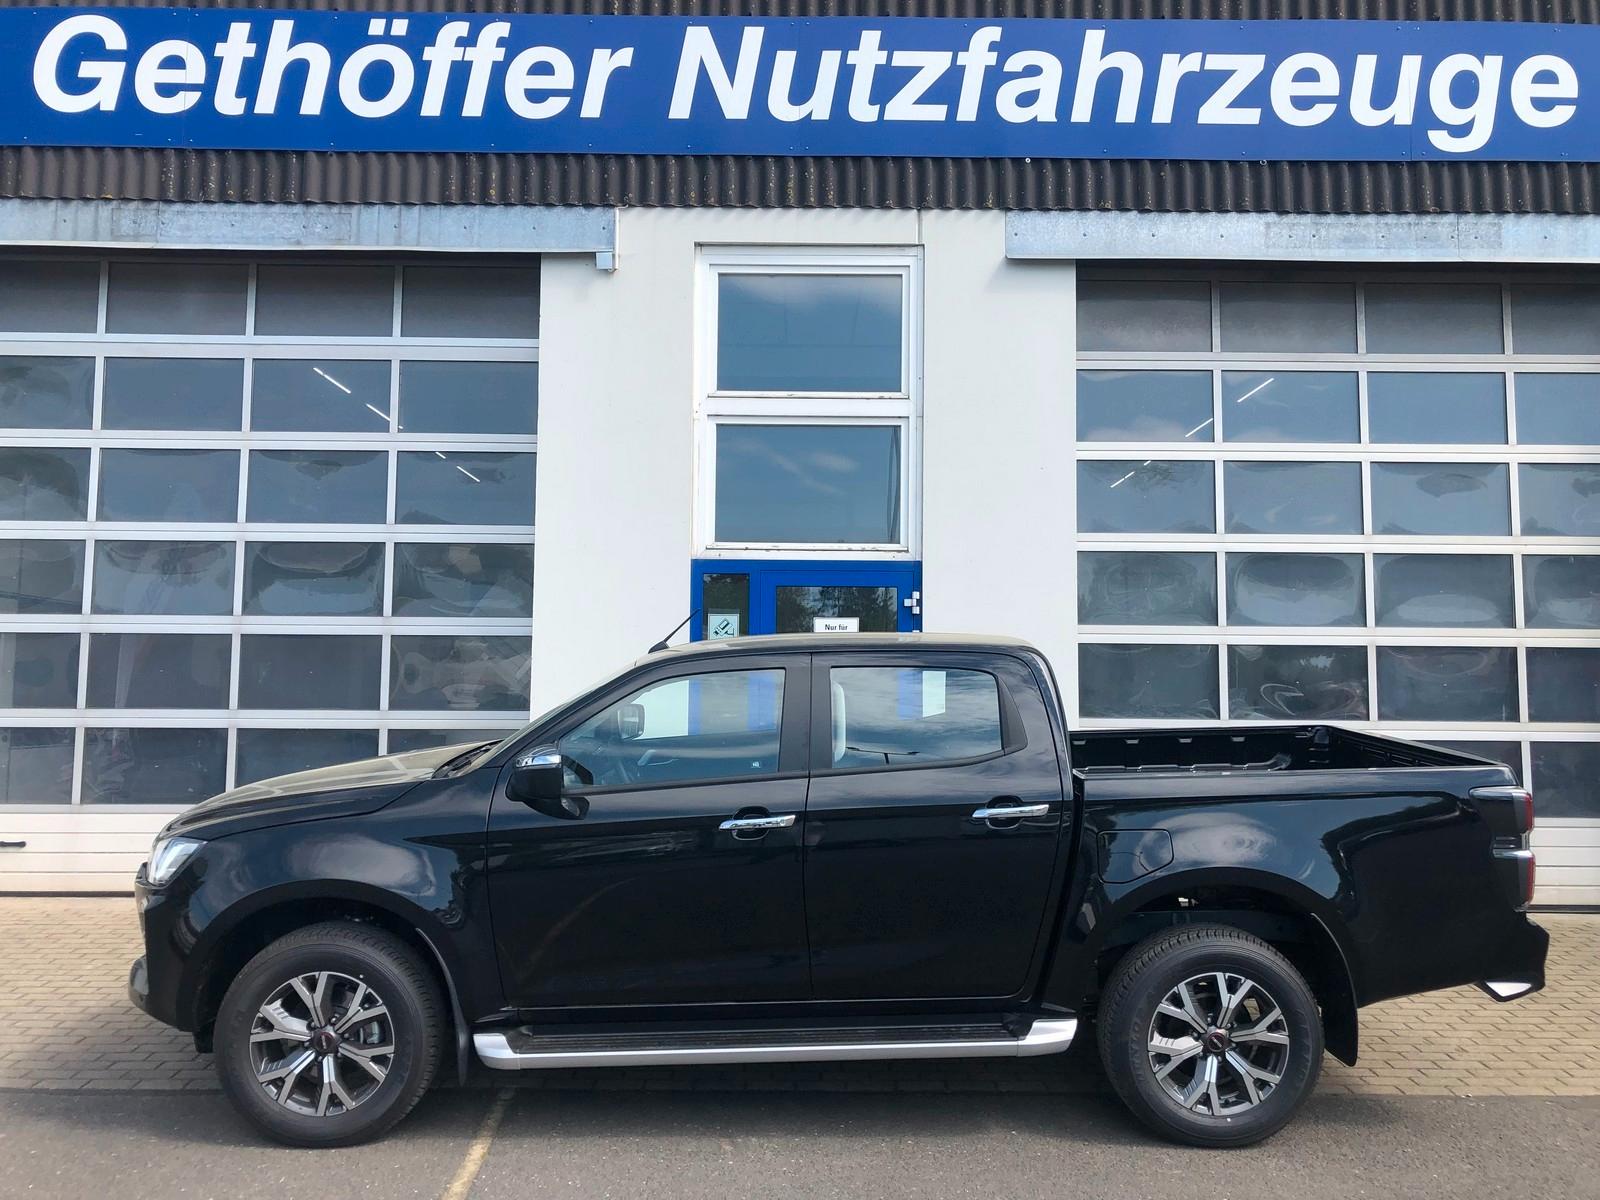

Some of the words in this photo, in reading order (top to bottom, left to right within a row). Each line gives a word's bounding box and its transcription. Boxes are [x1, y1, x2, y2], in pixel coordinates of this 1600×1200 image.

[33, 14, 635, 120] Gethöffer
[668, 26, 1579, 153] Nutzfahrzeuge
[824, 623, 837, 631] Nur
[838, 623, 848, 631] für
